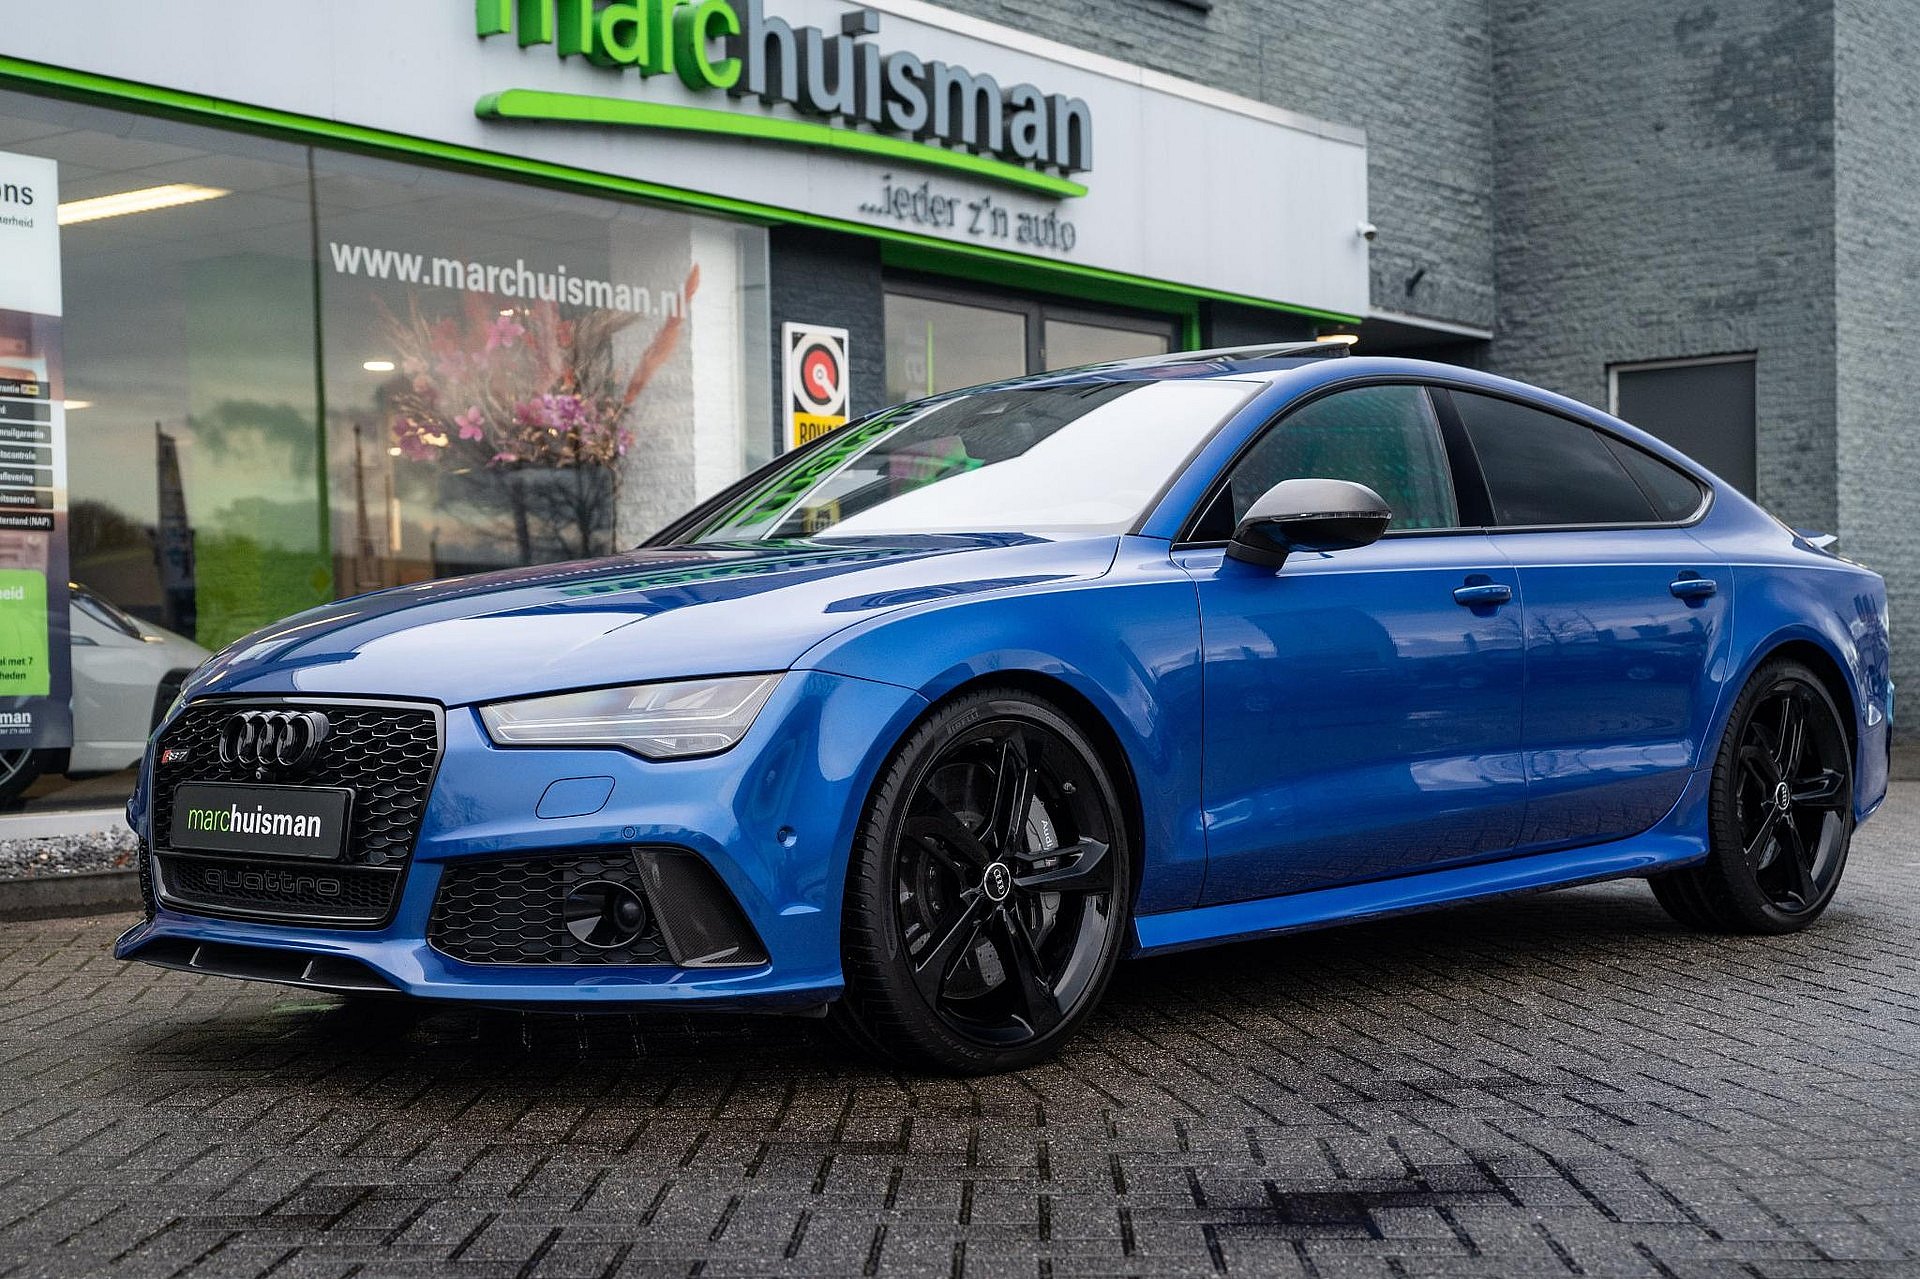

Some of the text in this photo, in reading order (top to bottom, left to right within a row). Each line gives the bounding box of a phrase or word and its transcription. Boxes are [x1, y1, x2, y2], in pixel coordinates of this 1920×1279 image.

[0, 183, 34, 206] ns
[1016, 208, 1077, 252] auto
[330, 242, 686, 319] www.marchuisman.nl
[187, 803, 322, 838] marchuisman
[204, 868, 341, 897] quattro
